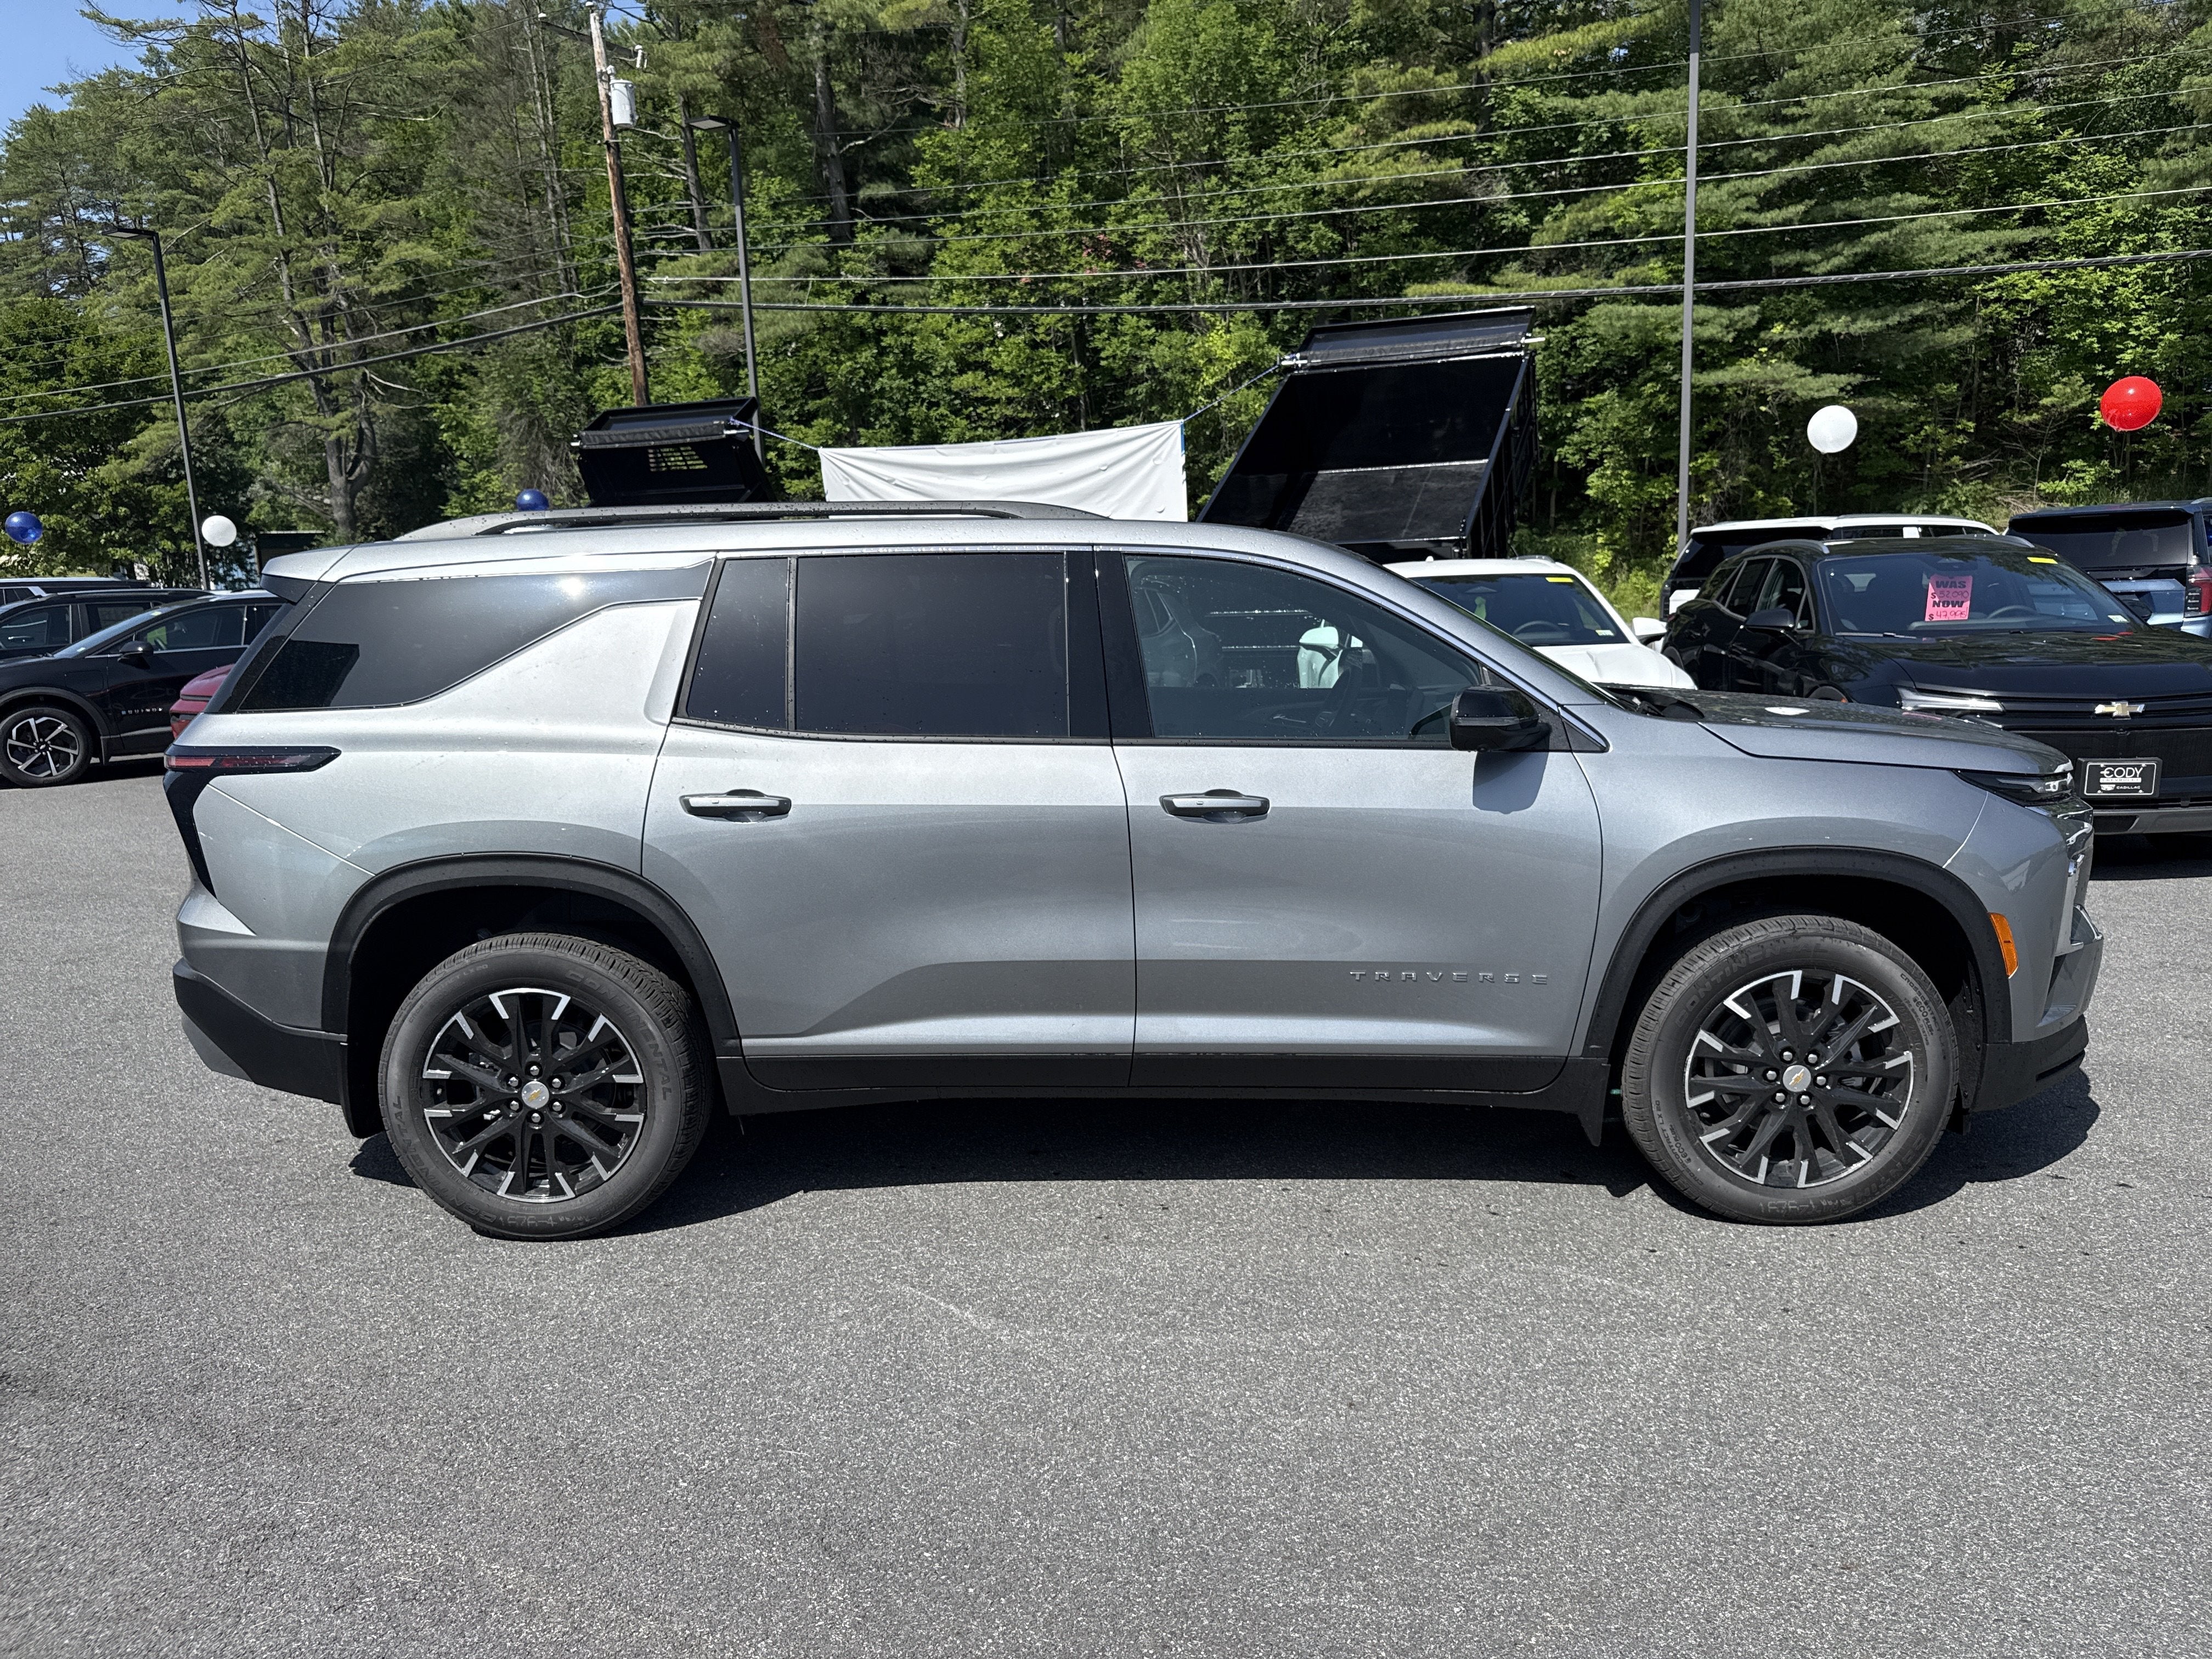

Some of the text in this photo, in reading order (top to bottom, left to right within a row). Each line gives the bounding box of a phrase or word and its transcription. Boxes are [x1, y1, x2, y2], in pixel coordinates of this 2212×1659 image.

[1935, 580, 1967, 589] WAS
[1932, 600, 1965, 608] NOW
[2100, 767, 2143, 778] CODY
[1349, 970, 1548, 985] TRAVERSE
[565, 969, 672, 1101] CONTINENTAL
